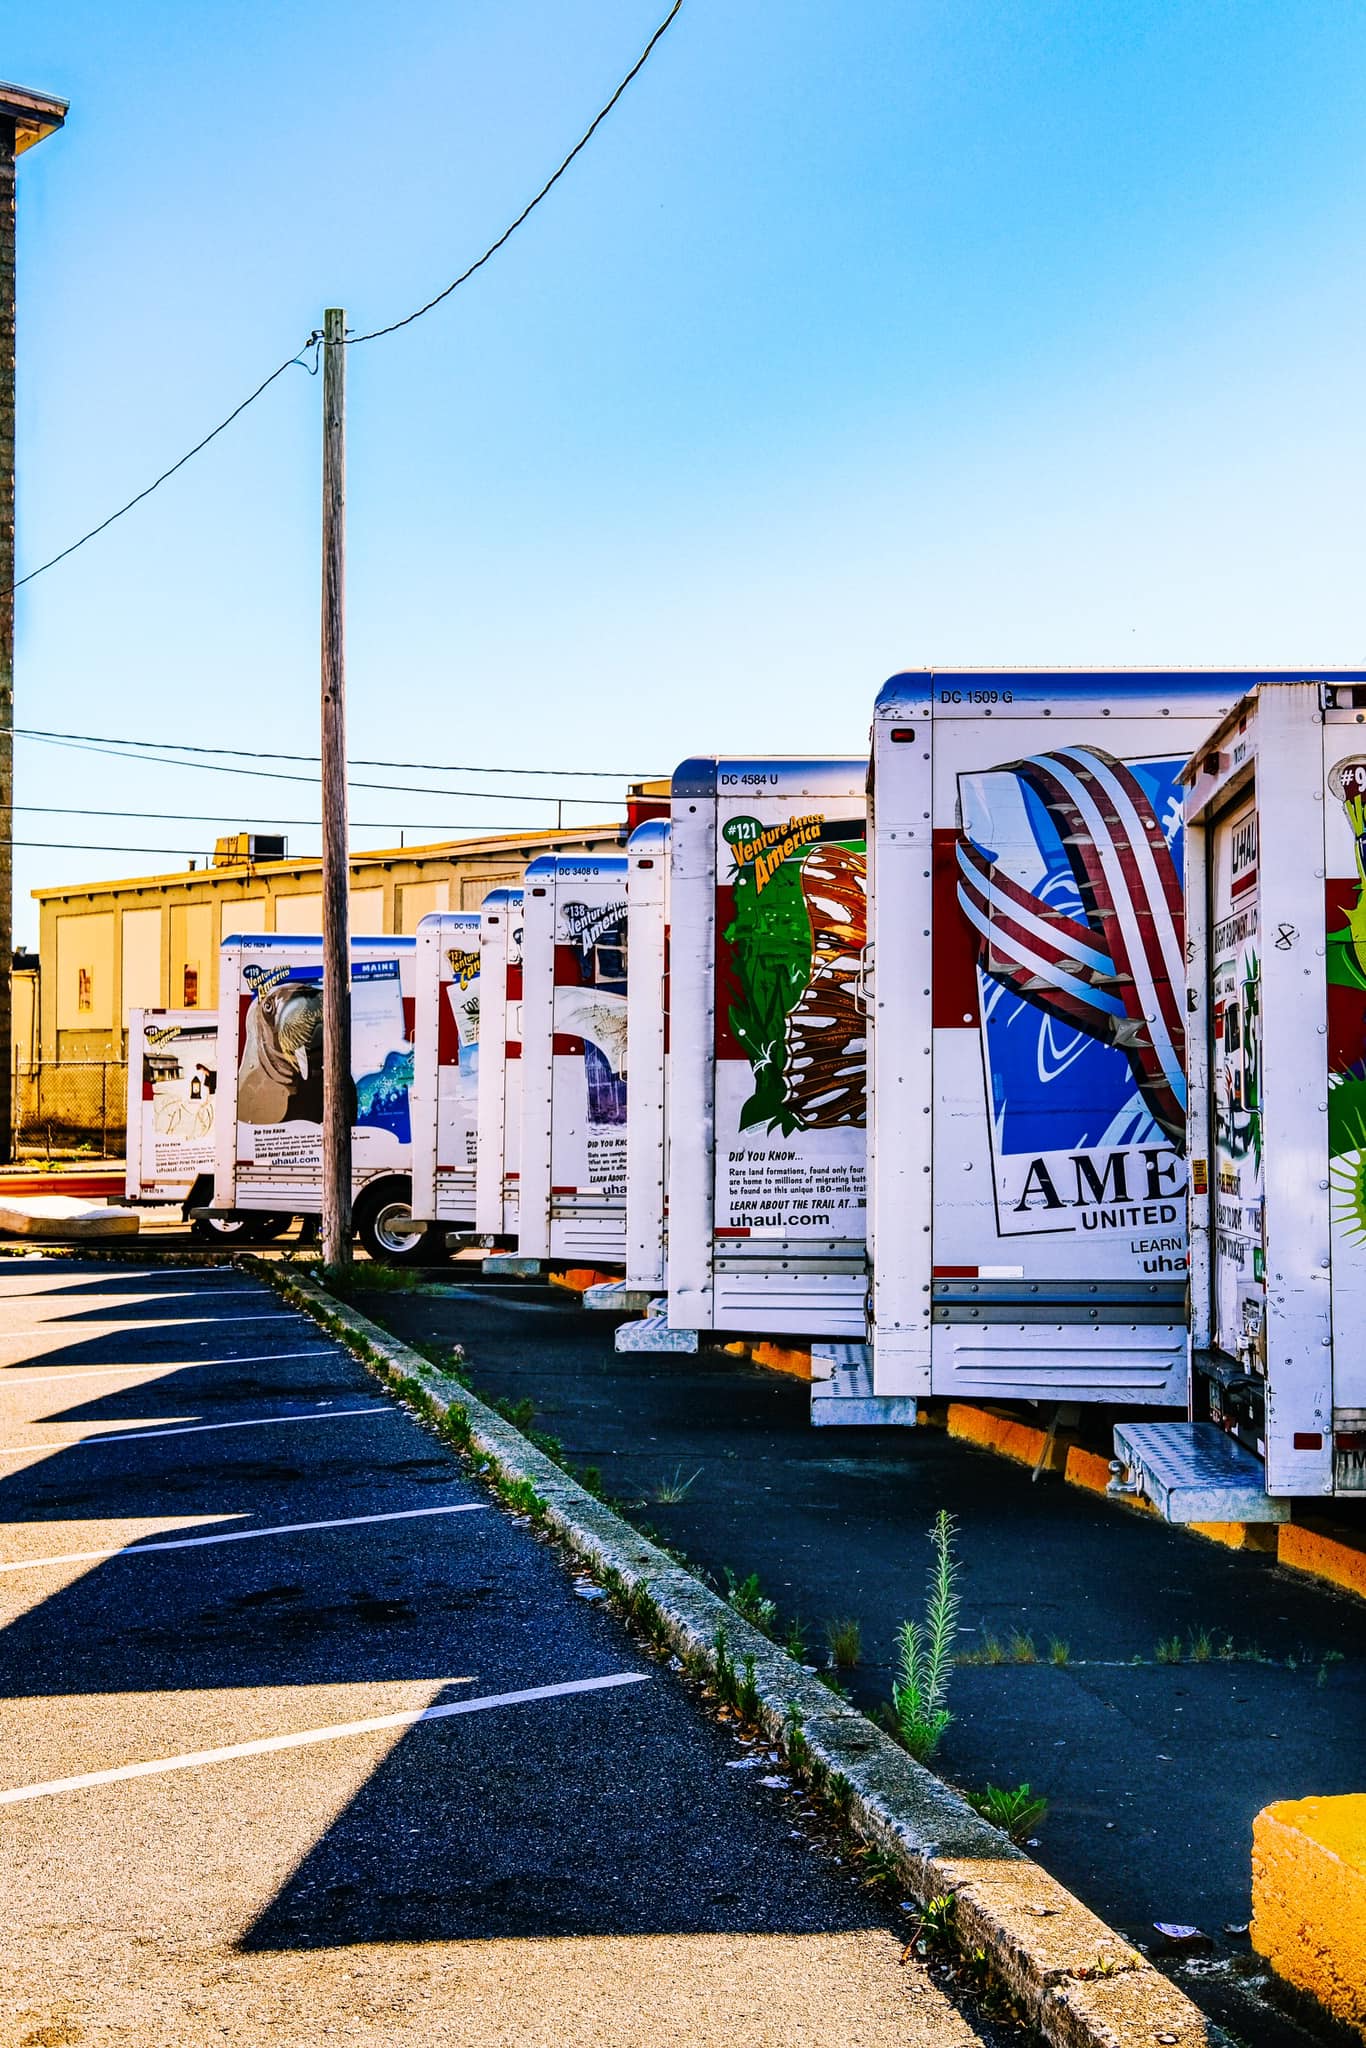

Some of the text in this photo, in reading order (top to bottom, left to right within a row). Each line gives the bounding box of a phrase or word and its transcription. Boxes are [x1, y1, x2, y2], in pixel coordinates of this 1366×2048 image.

[941, 690, 1013, 703] DC 1509 G
[721, 774, 778, 785] DC 4584 U
[727, 823, 756, 839] #121
[731, 813, 826, 867] Venture Across
[754, 824, 821, 896] America
[559, 867, 570, 875] DC
[593, 867, 599, 875] G
[568, 907, 606, 936] Venture
[582, 907, 628, 957] America
[362, 963, 395, 972] MAINE
[247, 970, 271, 989] Venture
[258, 970, 290, 1002] America
[272, 1156, 320, 1165] uhaul.com
[729, 1151, 745, 1162] DID
[748, 1150, 766, 1162] YOU
[729, 1165, 864, 1176] Rare land formations, found only four
[590, 1174, 627, 1183] LEARN ABOUT
[743, 1177, 762, 1185] home
[805, 1176, 813, 1184] of
[816, 1175, 849, 1185] migrating
[1013, 1148, 1187, 1212] AME
[603, 1184, 627, 1194] uha
[729, 1187, 737, 1195] be
[741, 1187, 760, 1195] found
[790, 1186, 813, 1195] unique
[816, 1185, 851, 1193] 180-mile
[730, 1200, 757, 1211] LEARN
[760, 1200, 790, 1210] ABOUT
[793, 1200, 808, 1209] THE
[812, 1199, 835, 1209] TRAIL
[730, 1213, 829, 1227] uhaul.com
[1082, 1205, 1177, 1230] UNITED
[1131, 1238, 1182, 1254] LEARN
[1143, 1255, 1187, 1273] uha
